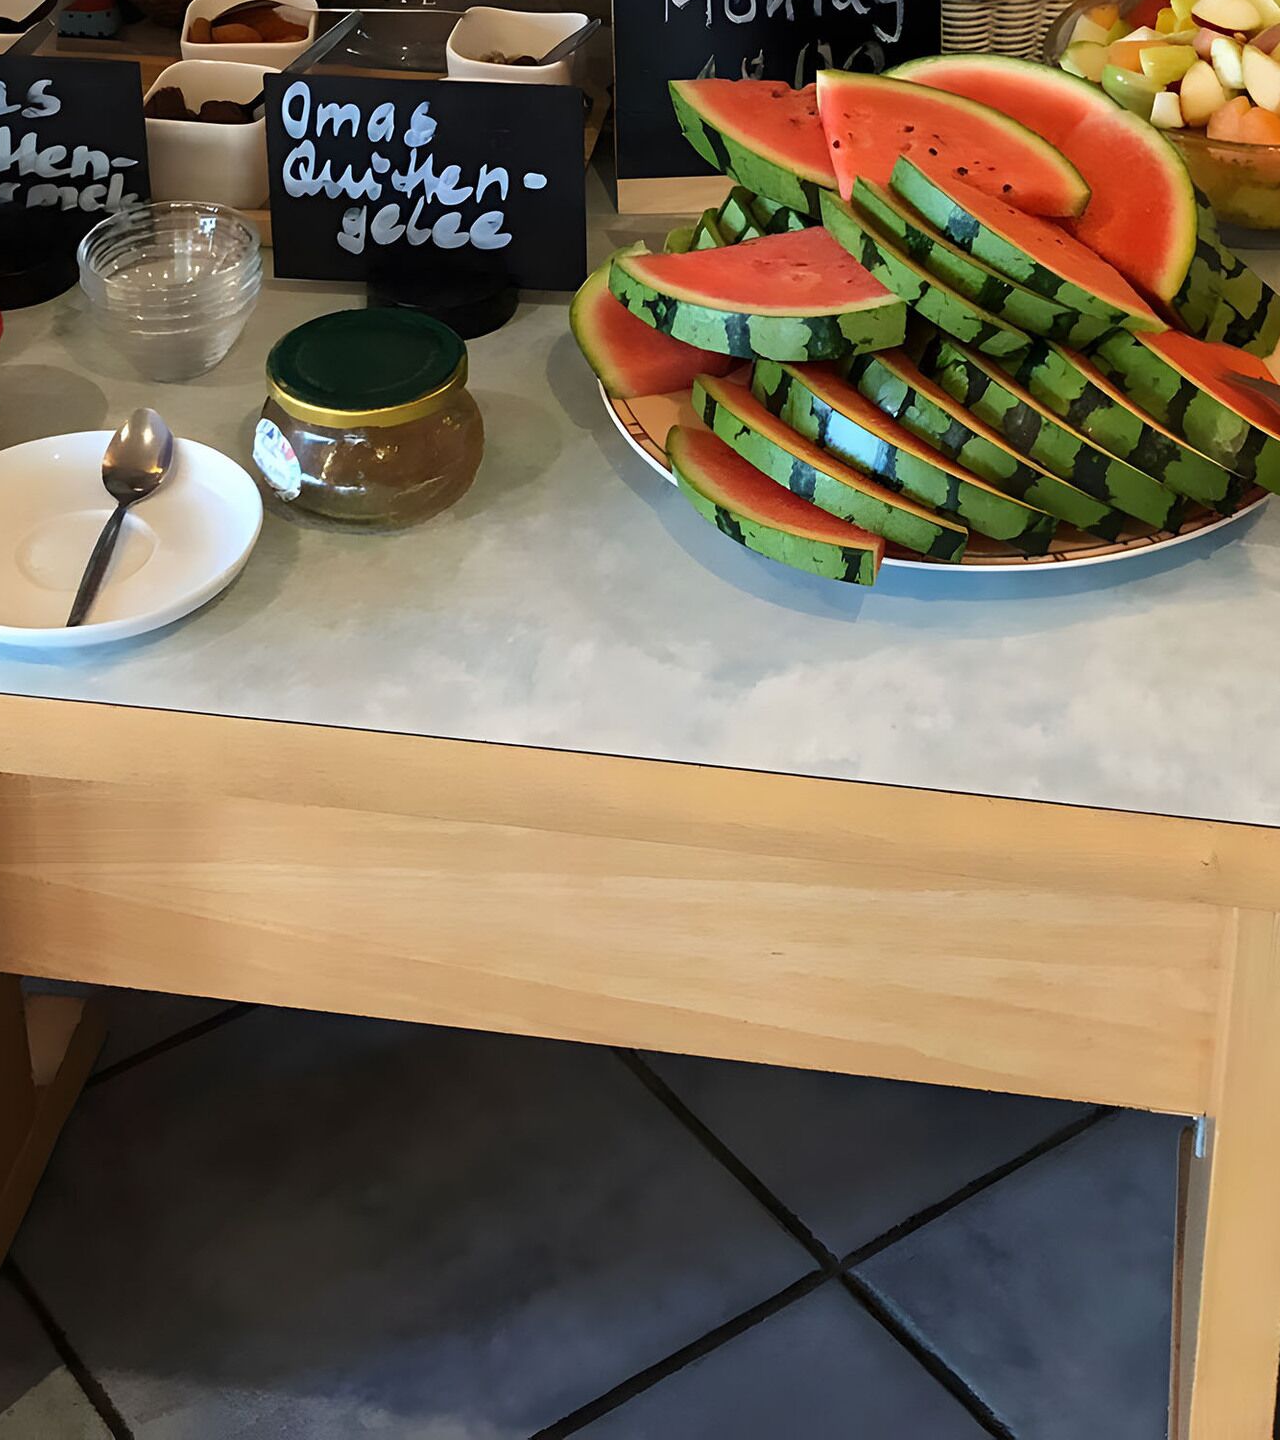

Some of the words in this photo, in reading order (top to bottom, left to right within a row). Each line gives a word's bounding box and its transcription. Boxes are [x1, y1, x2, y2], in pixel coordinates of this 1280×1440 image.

[281, 80, 440, 147] Omas
[281, 139, 548, 207] Quitten-
[337, 196, 513, 255] gelee
